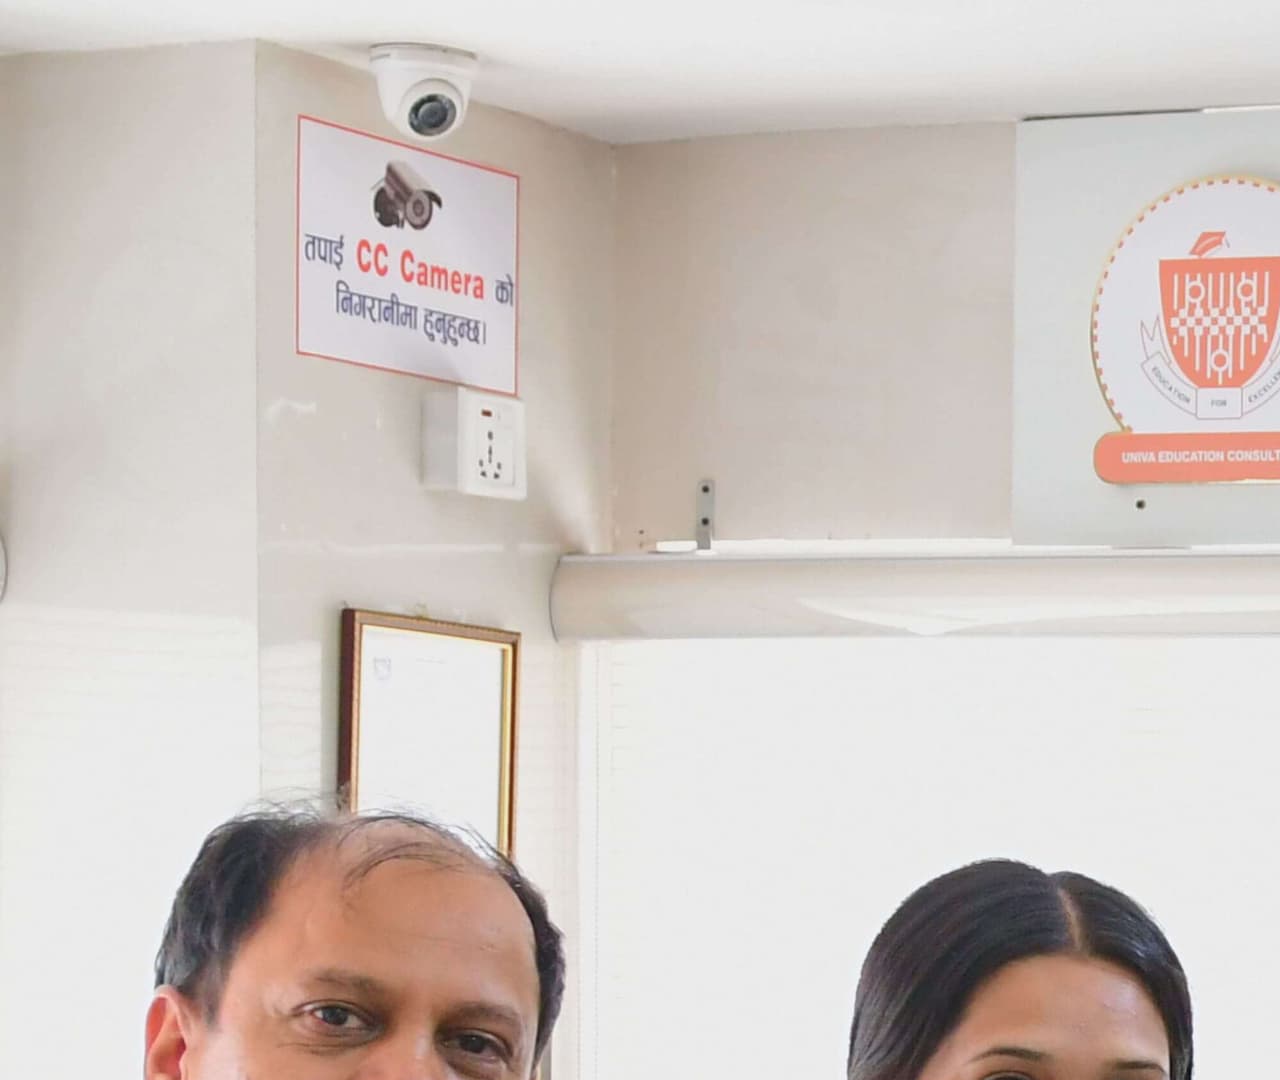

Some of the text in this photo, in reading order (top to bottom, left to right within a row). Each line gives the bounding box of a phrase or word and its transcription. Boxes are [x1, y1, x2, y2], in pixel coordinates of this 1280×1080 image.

[356, 239, 389, 277] CC
[400, 249, 485, 300] Camera
[495, 273, 514, 307] को
[335, 279, 418, 330] निगरानीमा
[1152, 367, 1190, 403] EDUCATION
[1210, 399, 1227, 408] FOR
[1123, 452, 1156, 463] UNIVA
[1160, 451, 1224, 463] EDUCATION
